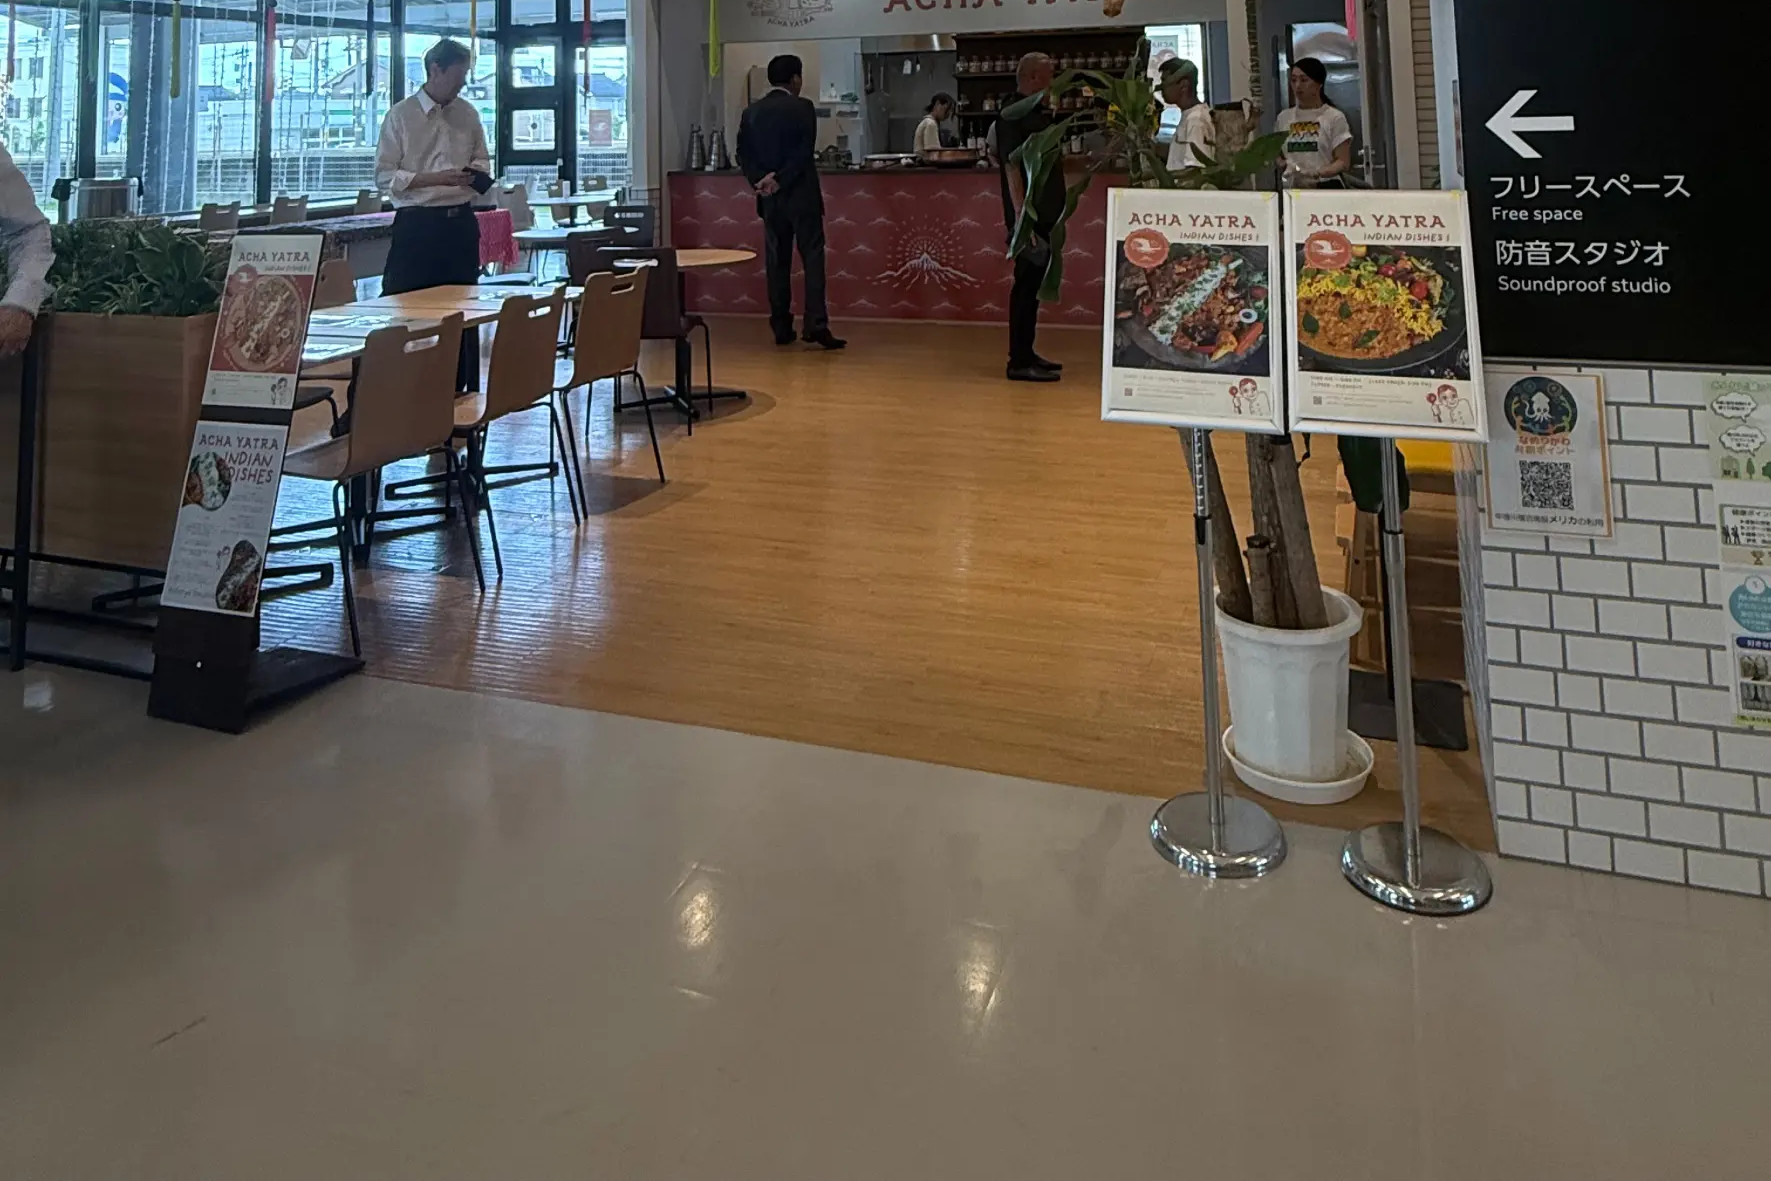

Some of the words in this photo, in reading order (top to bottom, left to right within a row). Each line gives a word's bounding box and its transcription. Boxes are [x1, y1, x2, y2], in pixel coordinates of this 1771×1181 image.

[1490, 173, 1691, 199] フリースペース
[1128, 212, 1182, 227] ACHA
[1188, 214, 1256, 229] YATRA
[1307, 214, 1365, 228] ACHA
[1372, 214, 1446, 229] YATRA
[1492, 206, 1529, 221] Free
[1533, 208, 1583, 224] space
[1179, 231, 1215, 240] INDIAN
[1363, 231, 1402, 241] INDIAN
[238, 251, 267, 262] ACHA
[272, 251, 310, 262] YATRA
[1495, 239, 1670, 266] 防音スタジオ
[1498, 275, 1607, 295] Soundproof
[1611, 277, 1671, 294] studio
[199, 434, 231, 448] ACHA
[236, 436, 279, 450] YATRA
[225, 451, 274, 468] INDIAN
